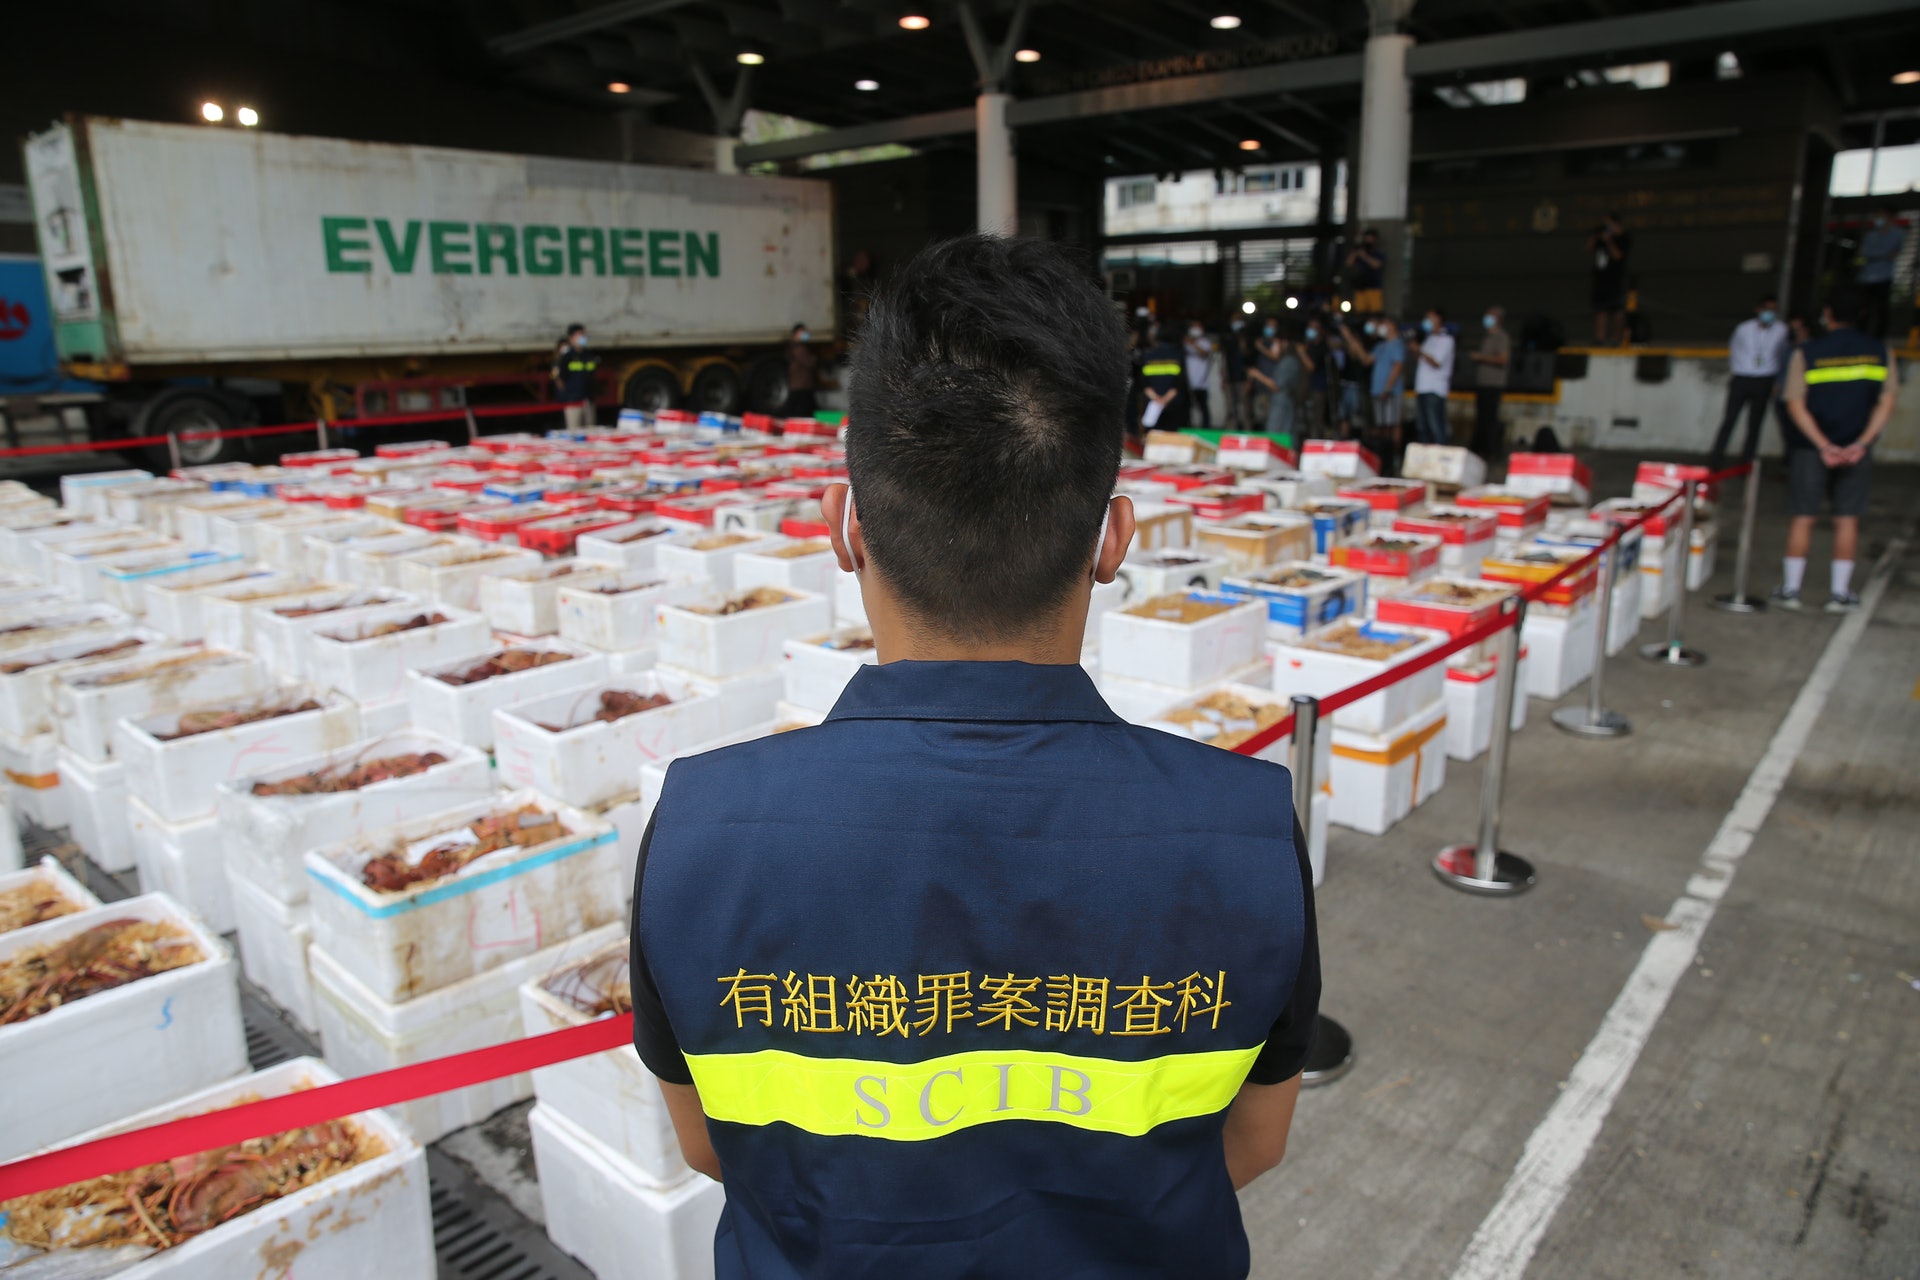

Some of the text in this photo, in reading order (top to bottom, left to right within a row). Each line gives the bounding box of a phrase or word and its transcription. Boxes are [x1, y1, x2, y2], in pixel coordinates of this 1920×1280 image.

[321, 216, 720, 278] EVERGREEN
[717, 967, 1232, 1039] 有組織罪案調查科
[853, 1063, 1092, 1129] SCIB
